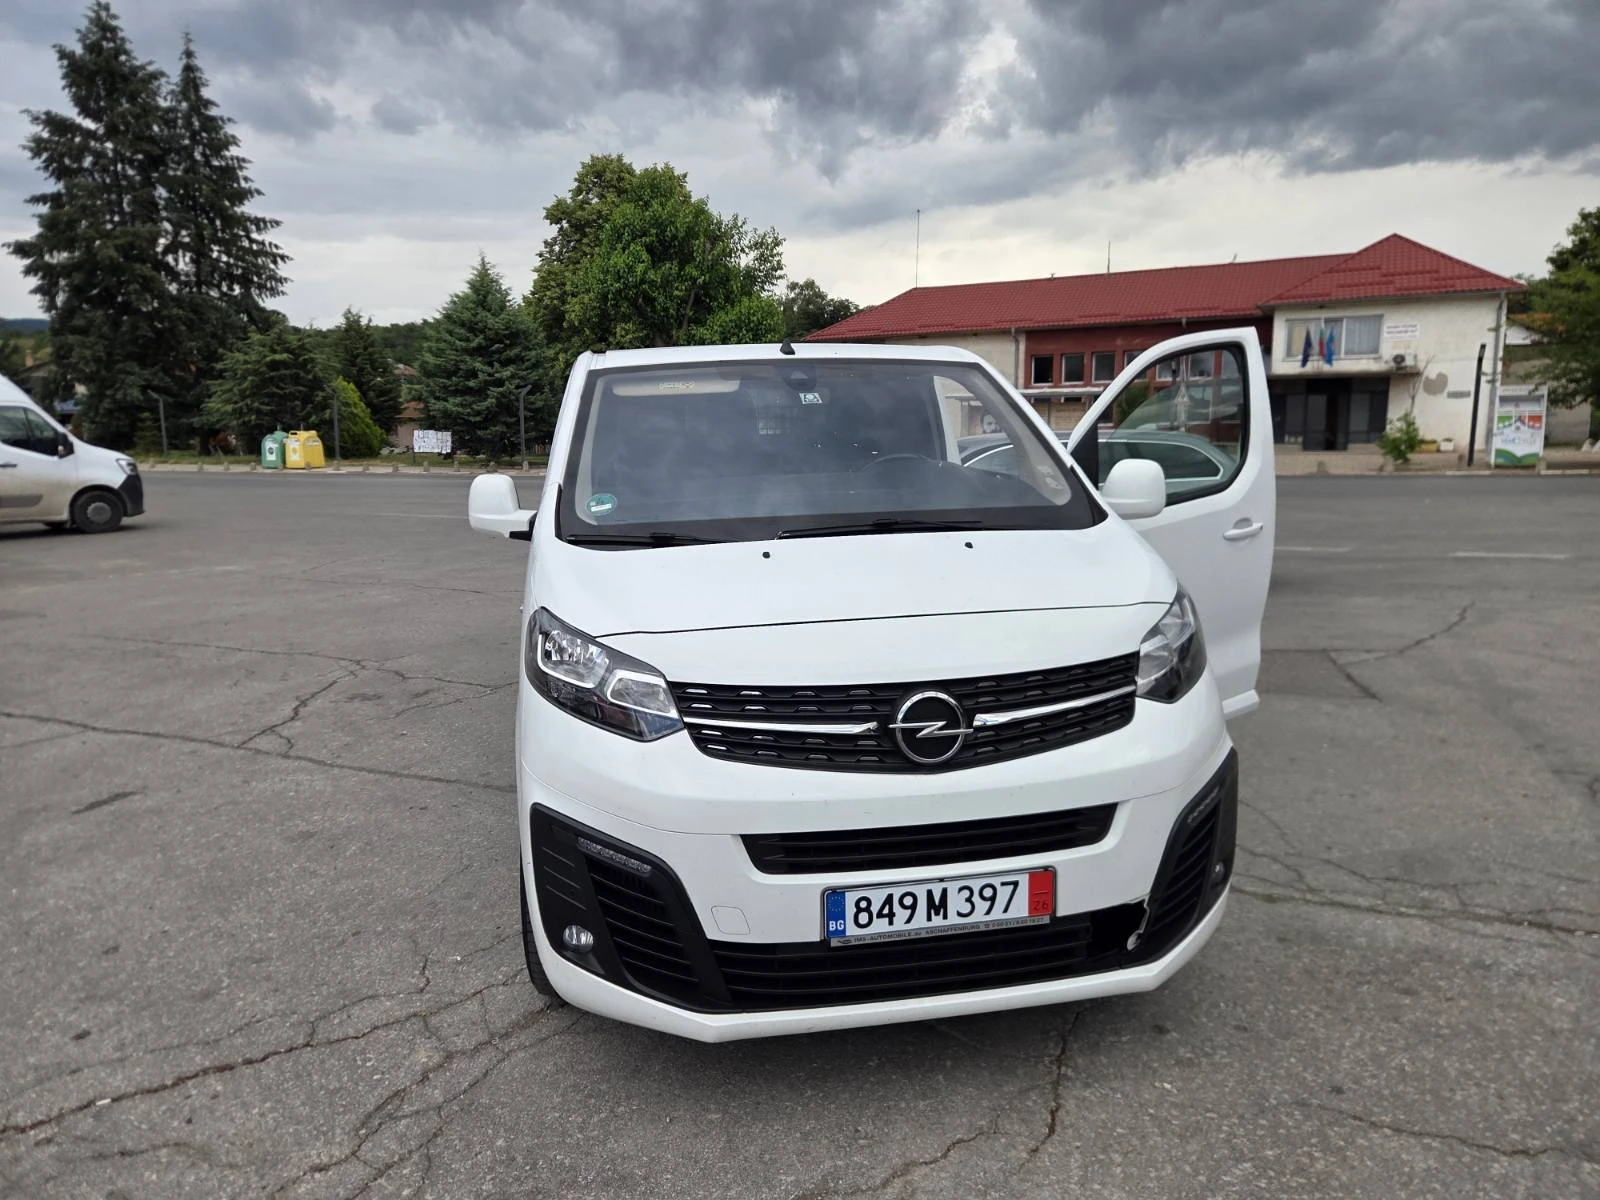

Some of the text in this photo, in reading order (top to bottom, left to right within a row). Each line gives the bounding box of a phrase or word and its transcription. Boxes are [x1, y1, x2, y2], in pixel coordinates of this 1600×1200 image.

[853, 880, 1019, 929] 849 M 397
[829, 919, 845, 932] BG
